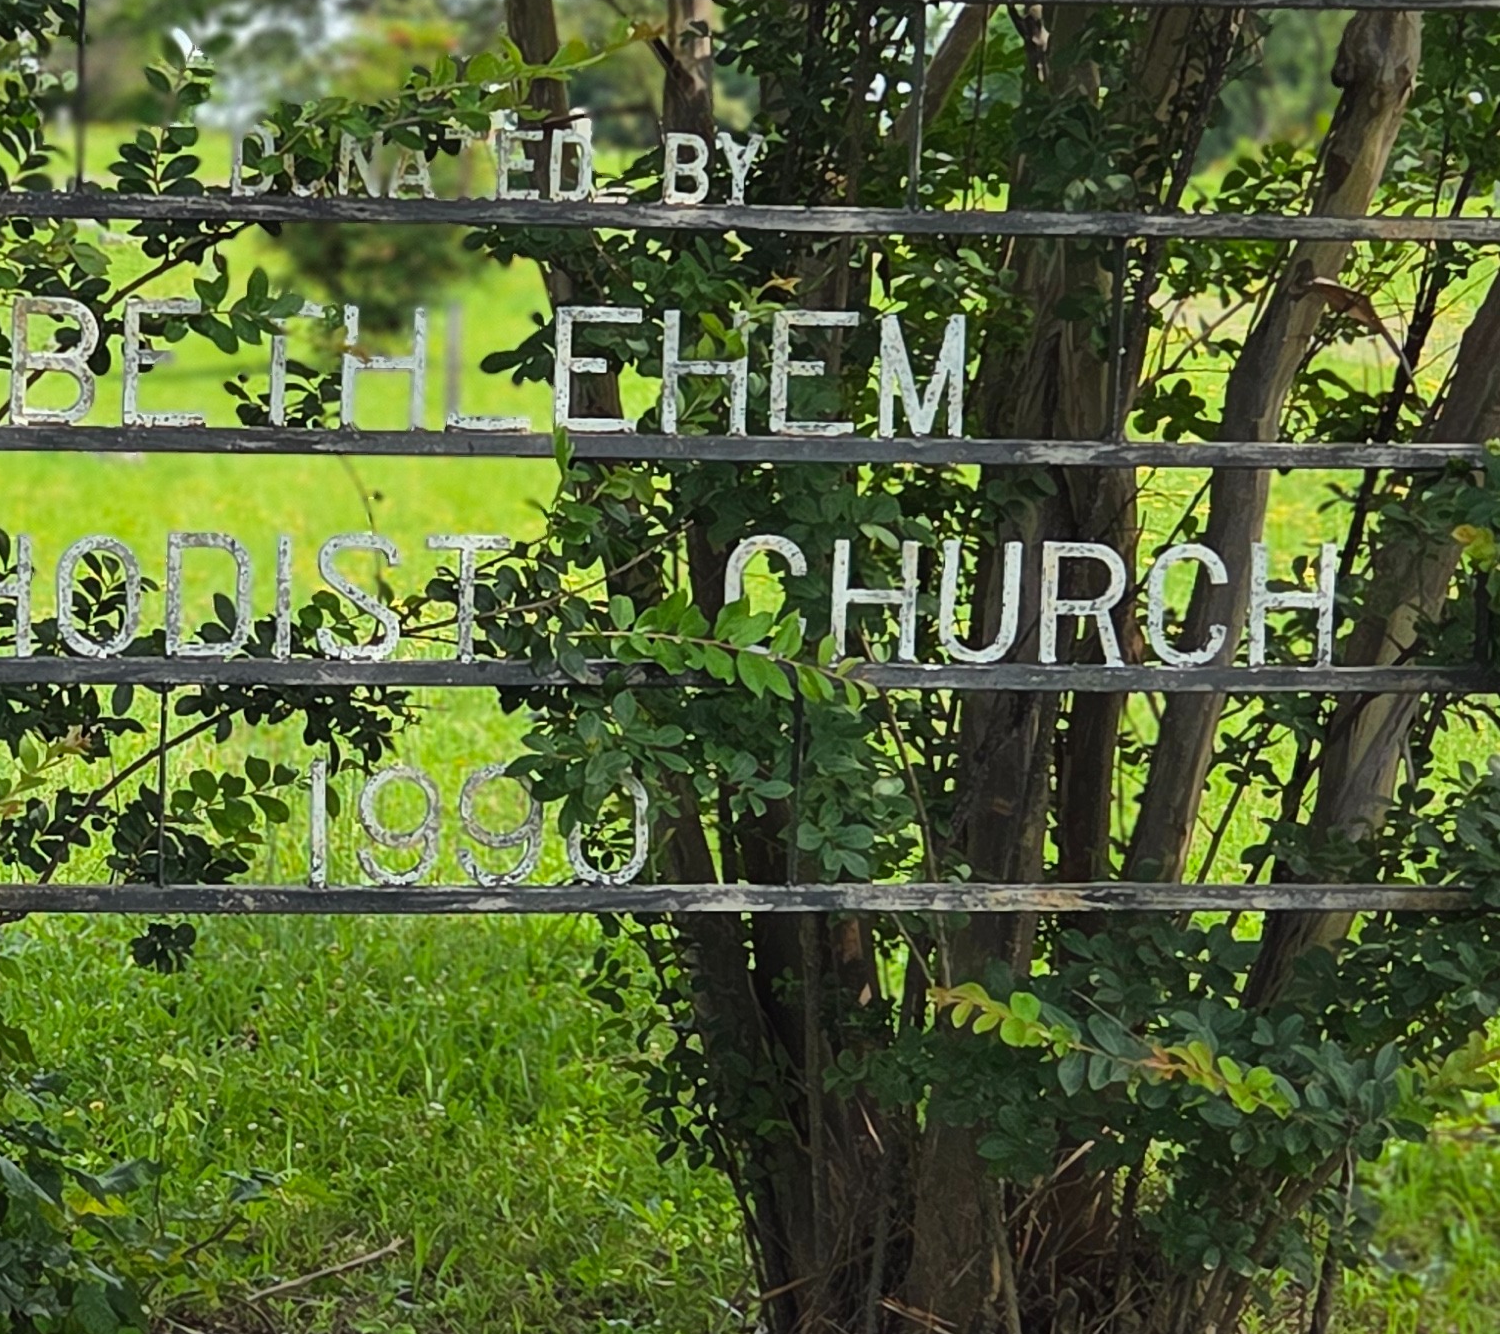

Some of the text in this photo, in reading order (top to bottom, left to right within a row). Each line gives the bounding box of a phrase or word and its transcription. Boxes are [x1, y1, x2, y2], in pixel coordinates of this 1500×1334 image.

[662, 130, 764, 205] BY
[8, 296, 967, 439] BETHLEHEM
[723, 533, 1339, 667] CHURCH
[309, 758, 650, 888] 1990
